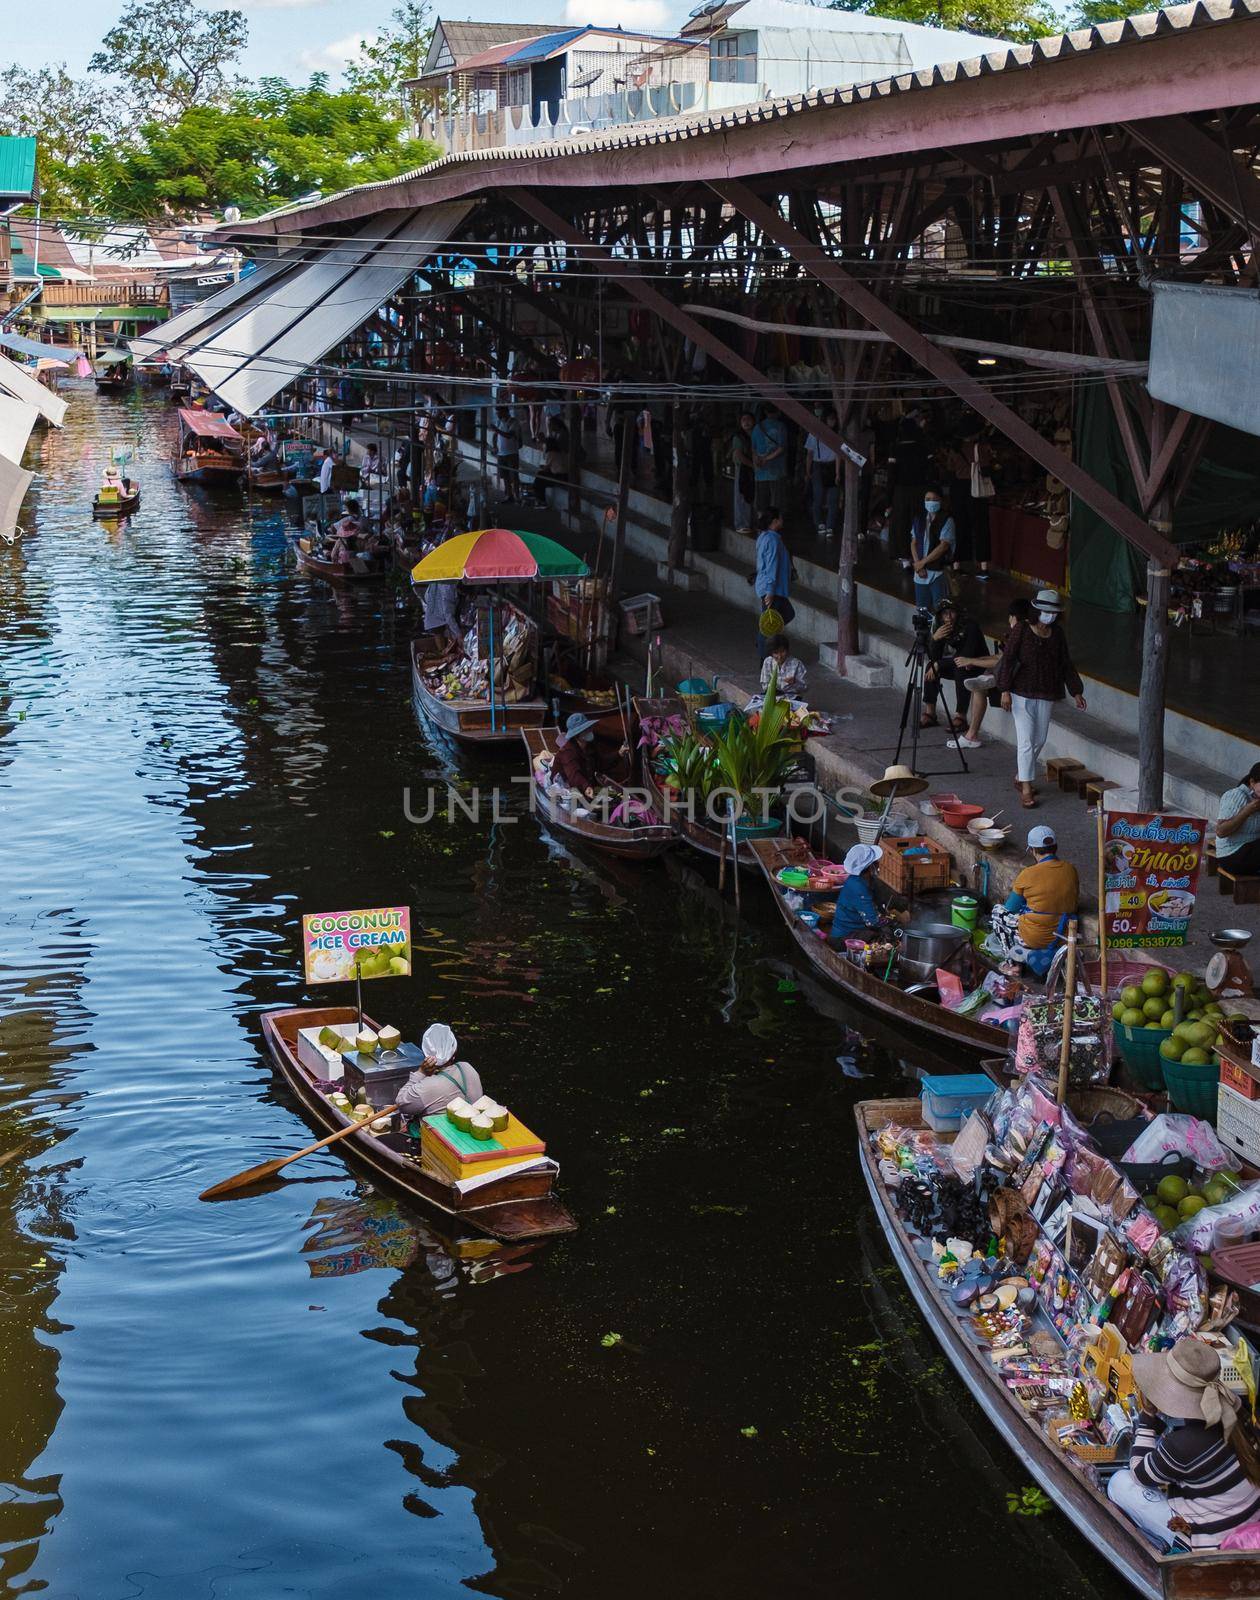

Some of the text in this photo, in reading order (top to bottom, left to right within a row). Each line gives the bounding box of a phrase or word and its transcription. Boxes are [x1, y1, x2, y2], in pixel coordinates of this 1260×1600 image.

[309, 912, 401, 933] COCONUT
[318, 931, 405, 949] ICE CREAM
